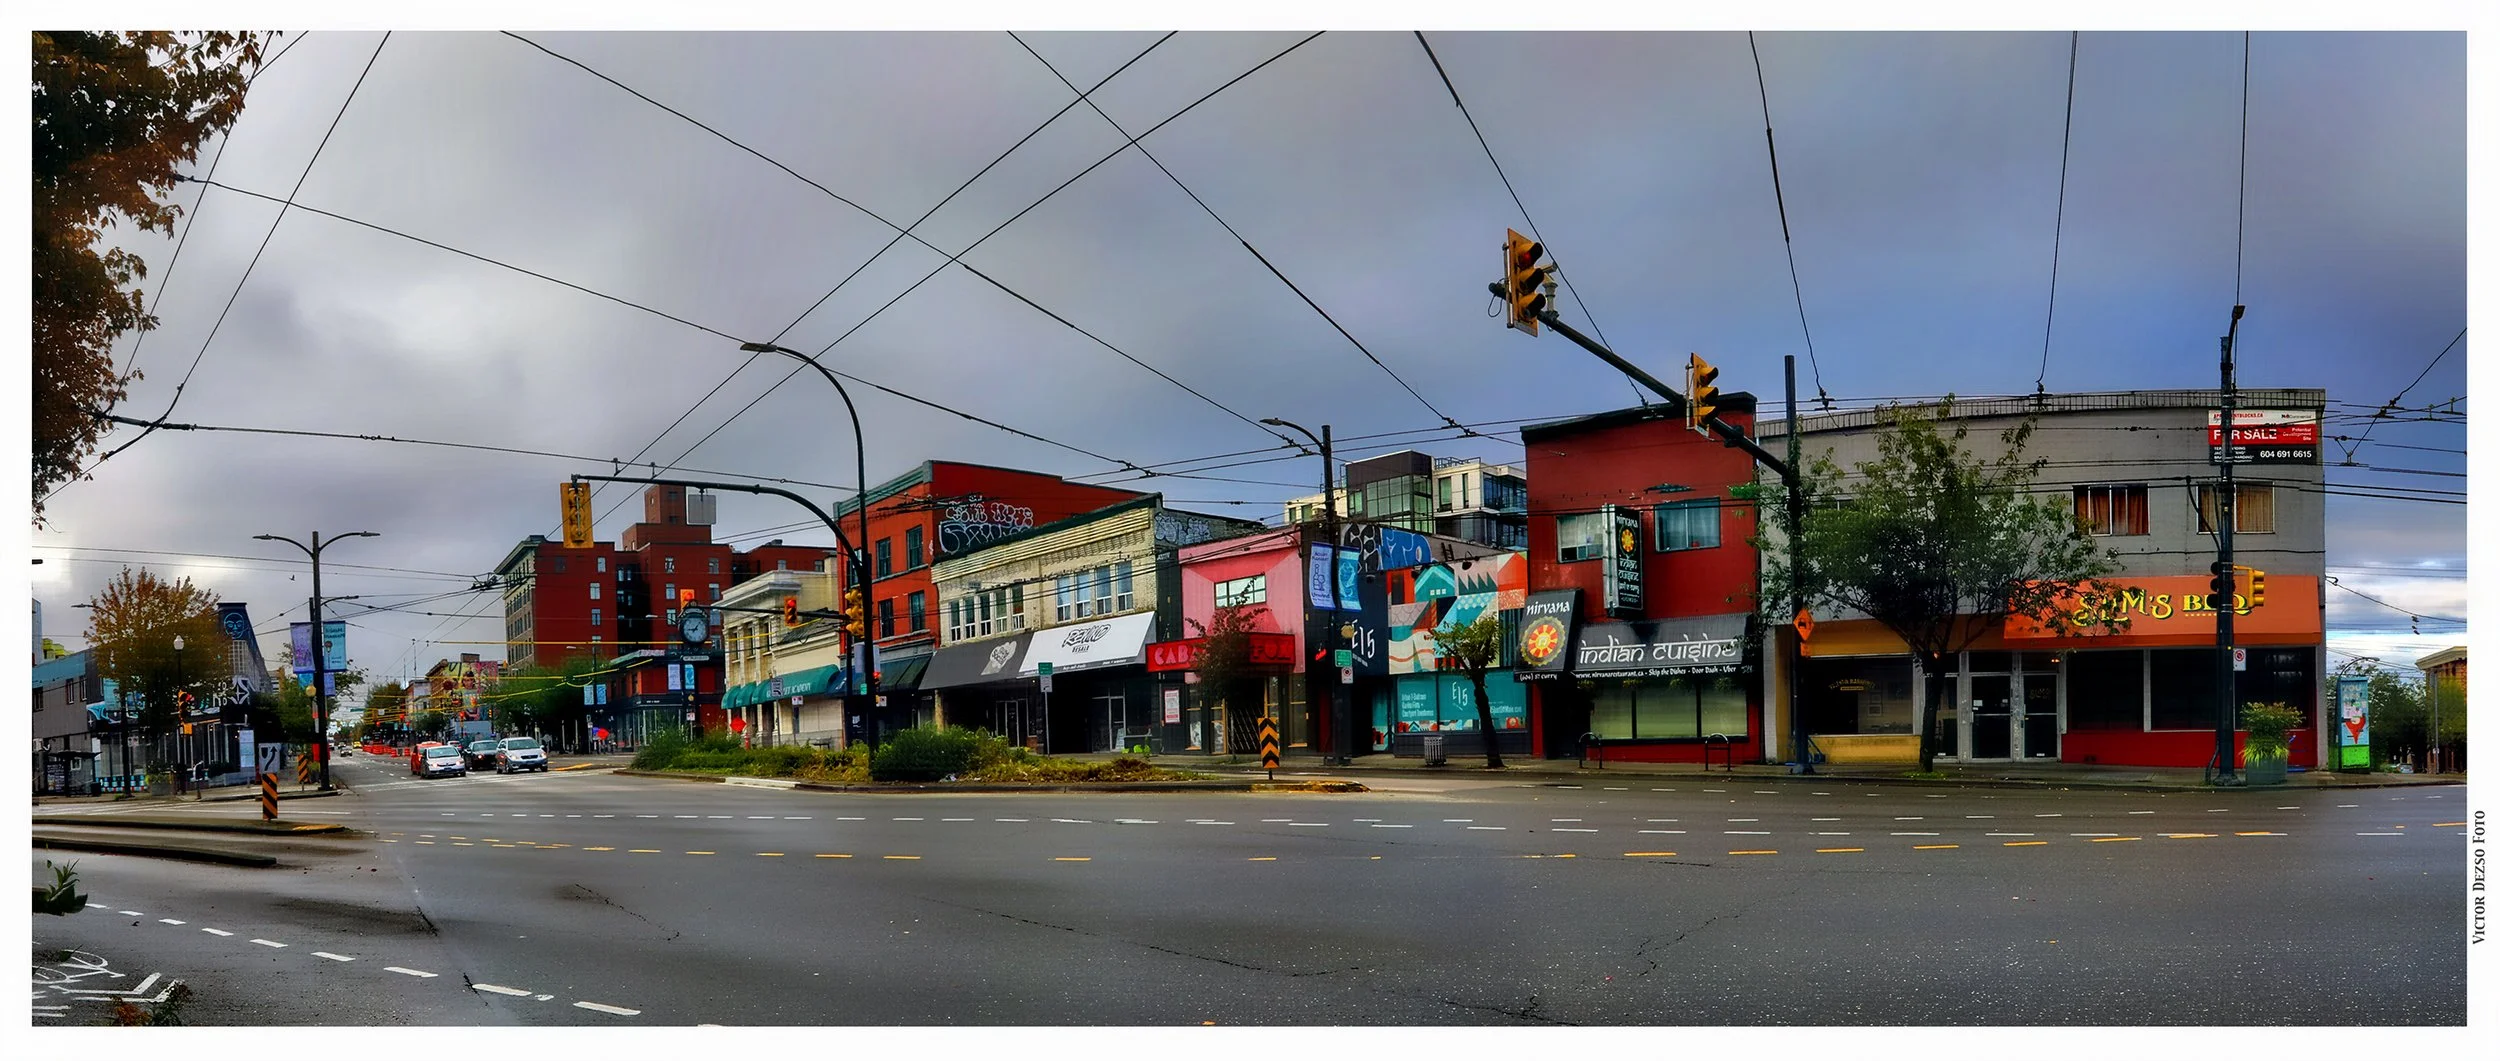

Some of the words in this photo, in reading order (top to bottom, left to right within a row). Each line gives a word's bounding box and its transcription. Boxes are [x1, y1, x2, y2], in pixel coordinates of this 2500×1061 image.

[2213, 429, 2240, 440] FR
[2259, 450, 2275, 458] 604
[2276, 450, 2291, 458] 691
[2293, 450, 2312, 458] 6615
[1526, 601, 1571, 616] nirvana
[2182, 594, 2250, 615] BQ
[1579, 635, 1647, 664] indian
[1653, 632, 1738, 662] cuisine
[1452, 681, 1468, 707] E15
